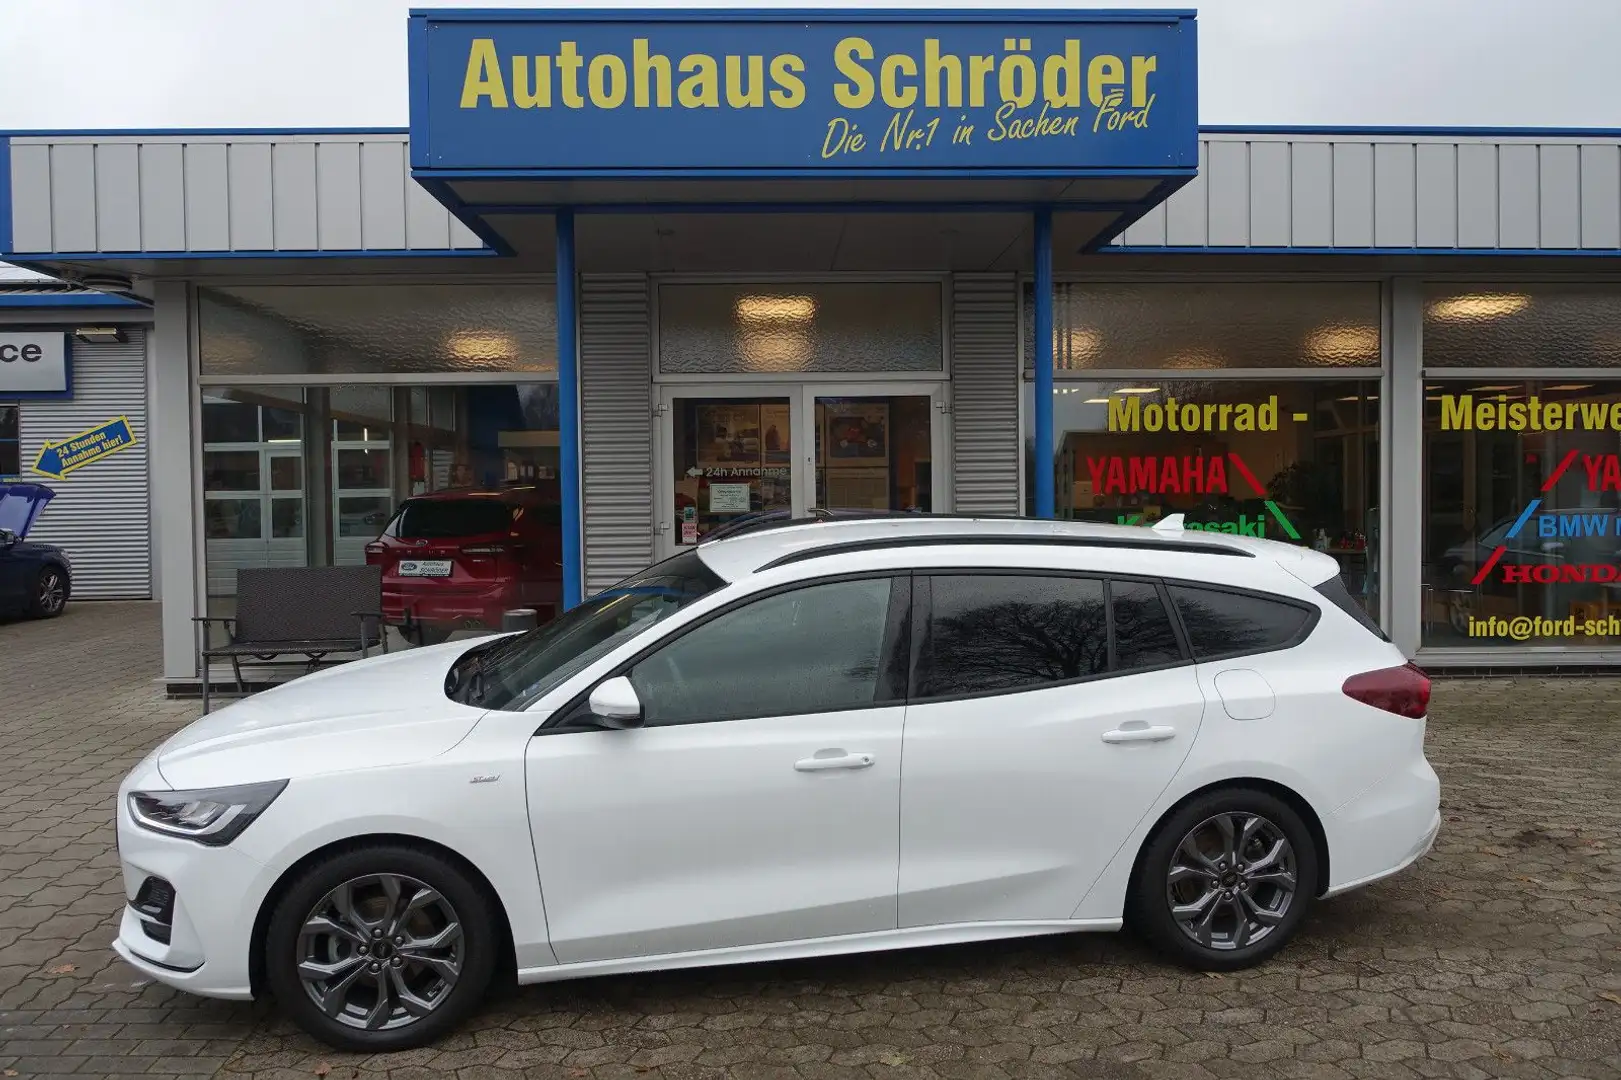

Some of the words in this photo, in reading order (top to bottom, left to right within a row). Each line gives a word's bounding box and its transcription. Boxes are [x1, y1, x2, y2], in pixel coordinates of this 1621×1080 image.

[460, 38, 806, 109] Autohaus
[833, 37, 1157, 109] Schröder
[821, 117, 867, 159] Die
[880, 109, 940, 152] Nr.1
[952, 115, 975, 145] in
[987, 101, 1080, 141] Sachen
[1093, 92, 1156, 133] Ford
[0, 344, 42, 362] ce
[1108, 395, 1279, 433] Motorrad
[1441, 394, 1621, 431] Meisterwe
[56, 447, 69, 459] 24
[70, 432, 107, 452] Stunden
[61, 445, 102, 468] Annahme
[102, 434, 124, 451] hier!
[705, 466, 727, 477] 24h
[1087, 456, 1229, 495] YAMAHA
[1582, 454, 1621, 491] YA
[1539, 514, 1608, 538] BMW
[1503, 564, 1621, 584] HOND
[1468, 616, 1621, 640] info@ford-sch
